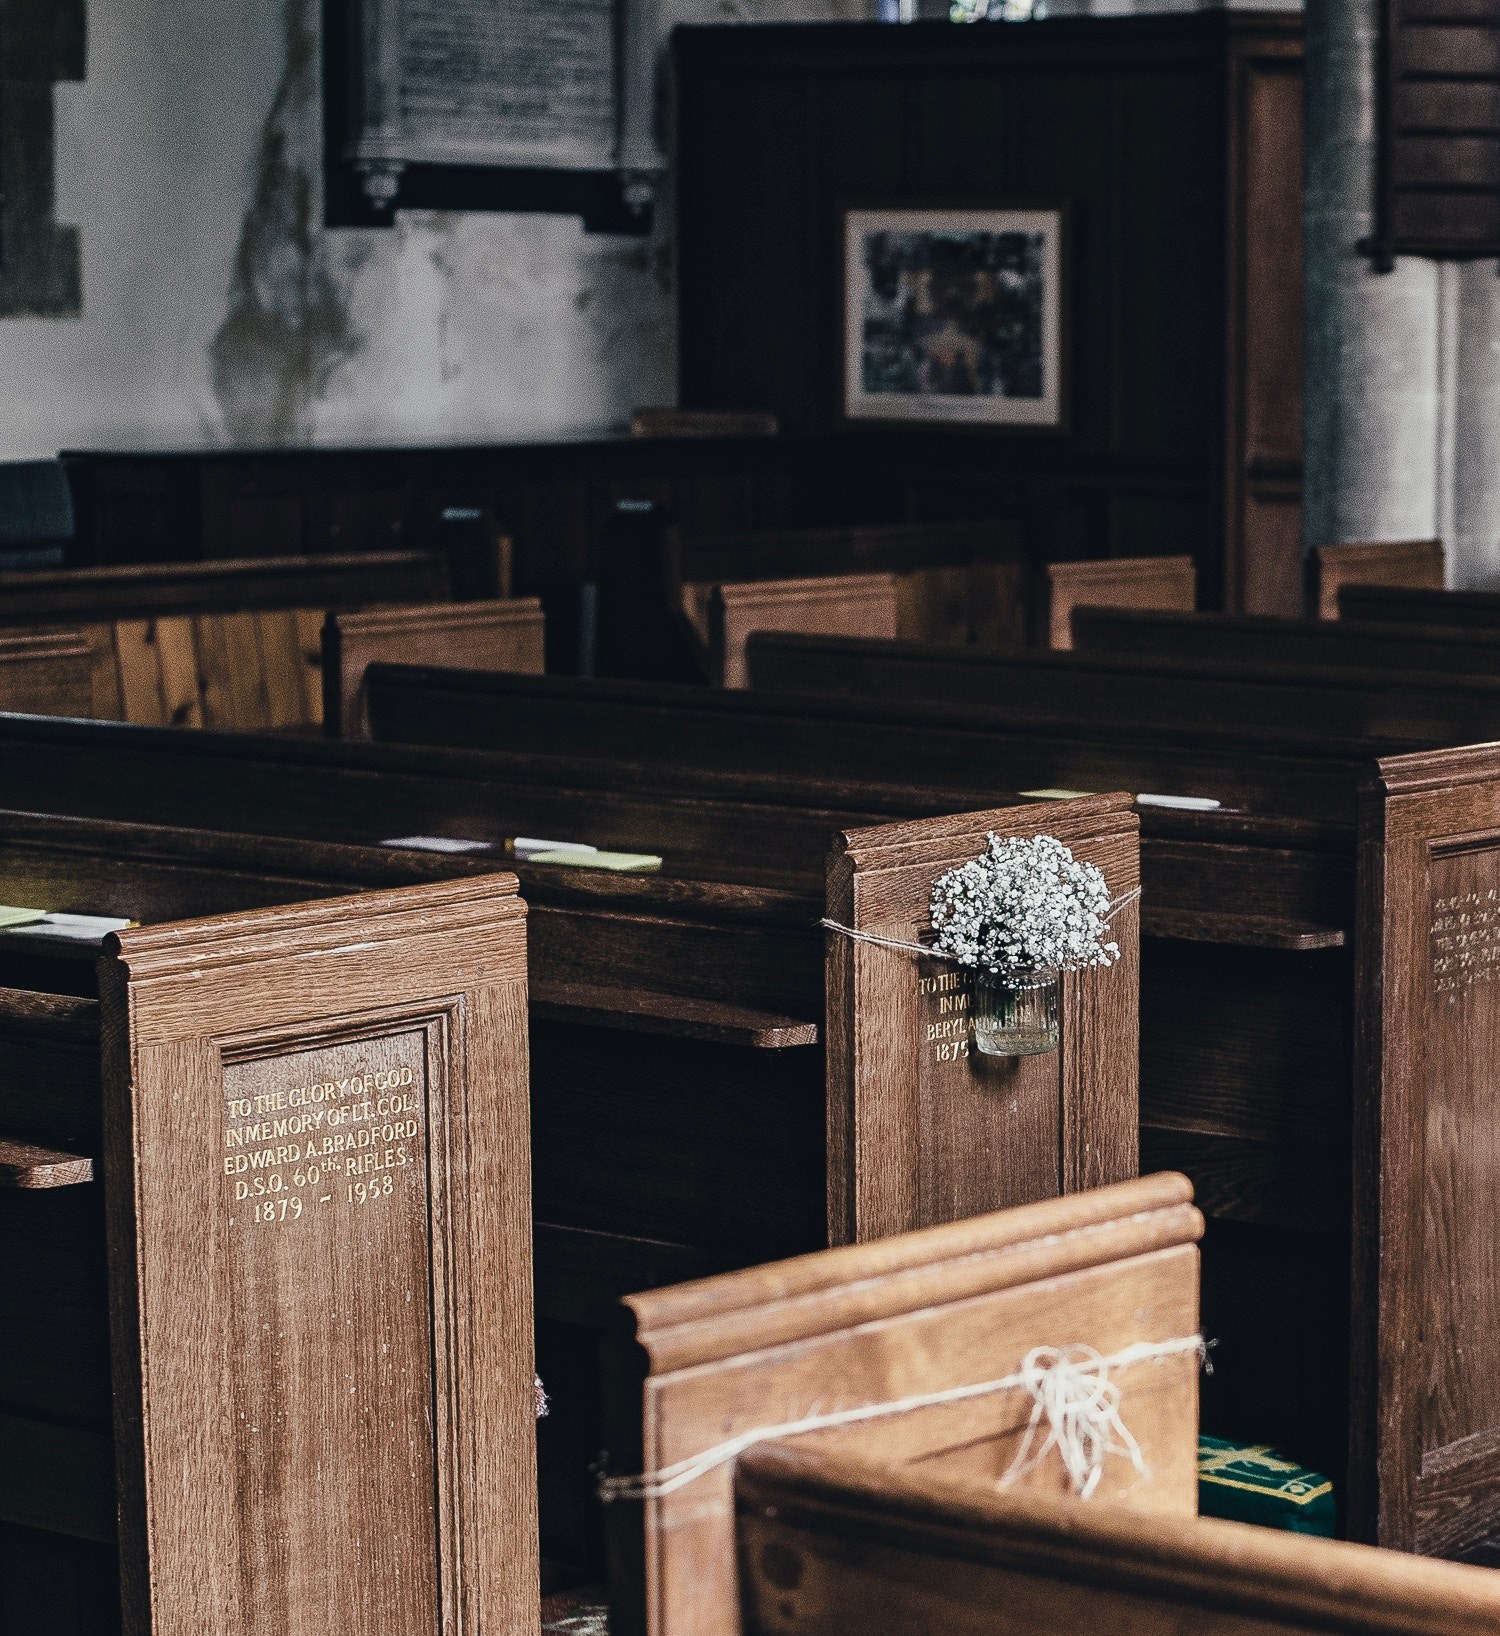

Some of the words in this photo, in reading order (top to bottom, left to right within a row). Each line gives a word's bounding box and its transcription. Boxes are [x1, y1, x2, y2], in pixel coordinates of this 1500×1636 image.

[919, 977, 937, 995] TO
[937, 972, 960, 991] THE
[939, 996, 953, 1014] IN
[927, 1017, 966, 1041] BERYL
[936, 1040, 970, 1062] 1875
[228, 1098, 252, 1118] TO
[254, 1091, 287, 1115] THE
[288, 1079, 350, 1108] GLORY
[350, 1073, 374, 1095] OF
[374, 1067, 413, 1090] GOD
[225, 1126, 244, 1148] IN
[244, 1110, 325, 1142] MEMORY
[327, 1107, 350, 1127] OF
[352, 1102, 376, 1121] LT.
[377, 1094, 420, 1117] COL.
[224, 1143, 301, 1175] EDWARD
[235, 1173, 289, 1201] D.S.O.
[346, 1147, 415, 1177] RIFLES.
[253, 1197, 303, 1223] 1879
[347, 1175, 395, 1205] 1958
